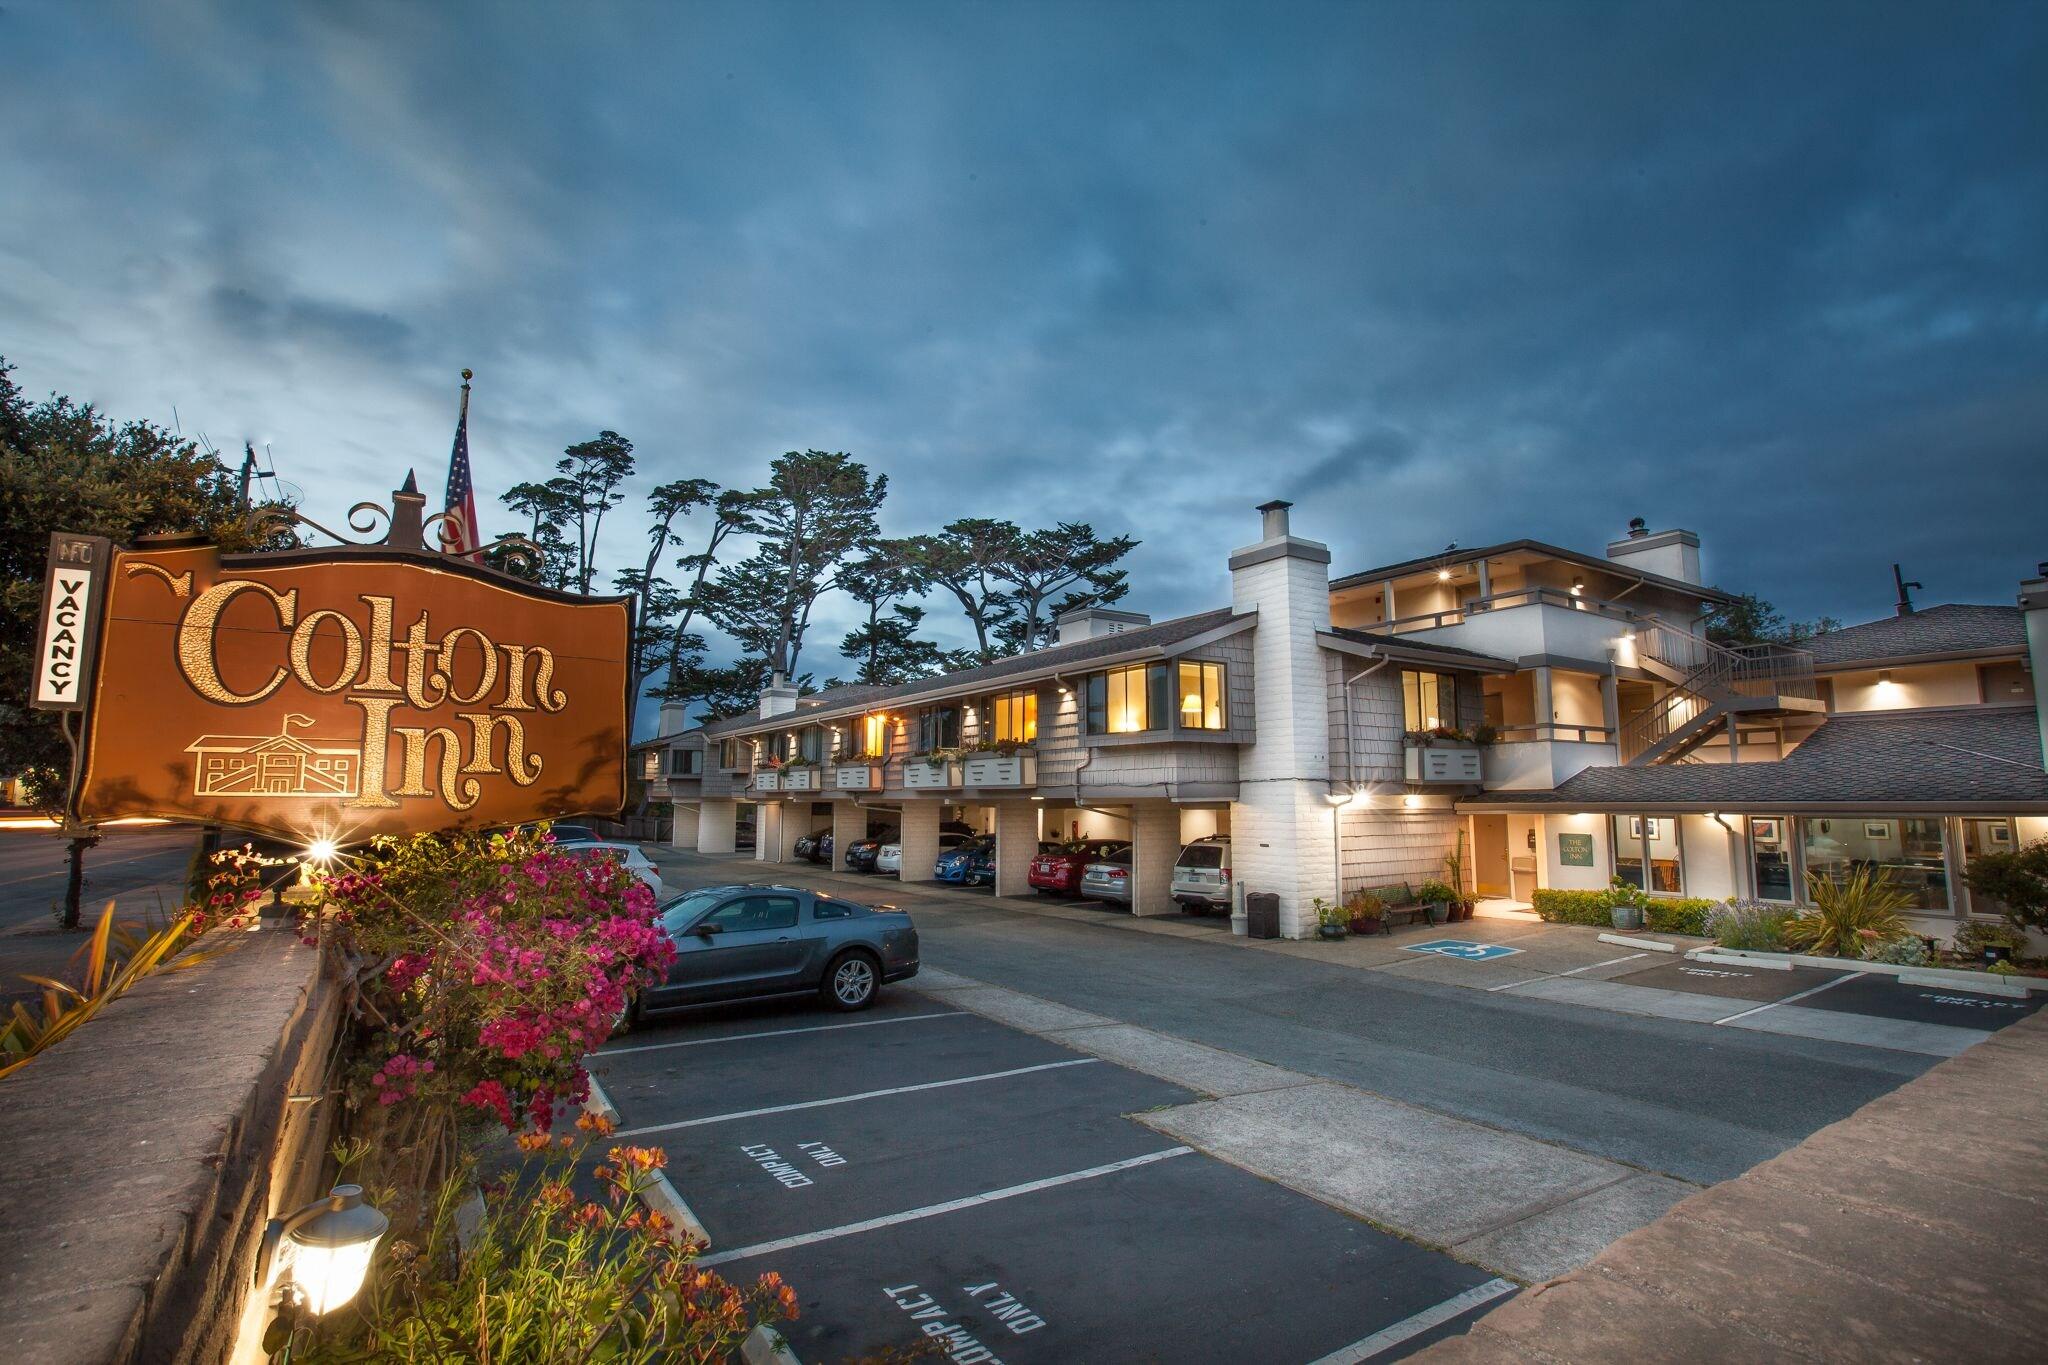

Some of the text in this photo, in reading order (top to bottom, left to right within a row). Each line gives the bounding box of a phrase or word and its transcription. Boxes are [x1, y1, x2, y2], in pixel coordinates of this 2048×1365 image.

[48, 579, 84, 695] VACANCY
[174, 577, 568, 714] Colton
[340, 694, 544, 812] Inn
[740, 1143, 815, 1189] COMPACT
[797, 1141, 848, 1167] ONLY
[963, 1281, 1048, 1335] ONLY
